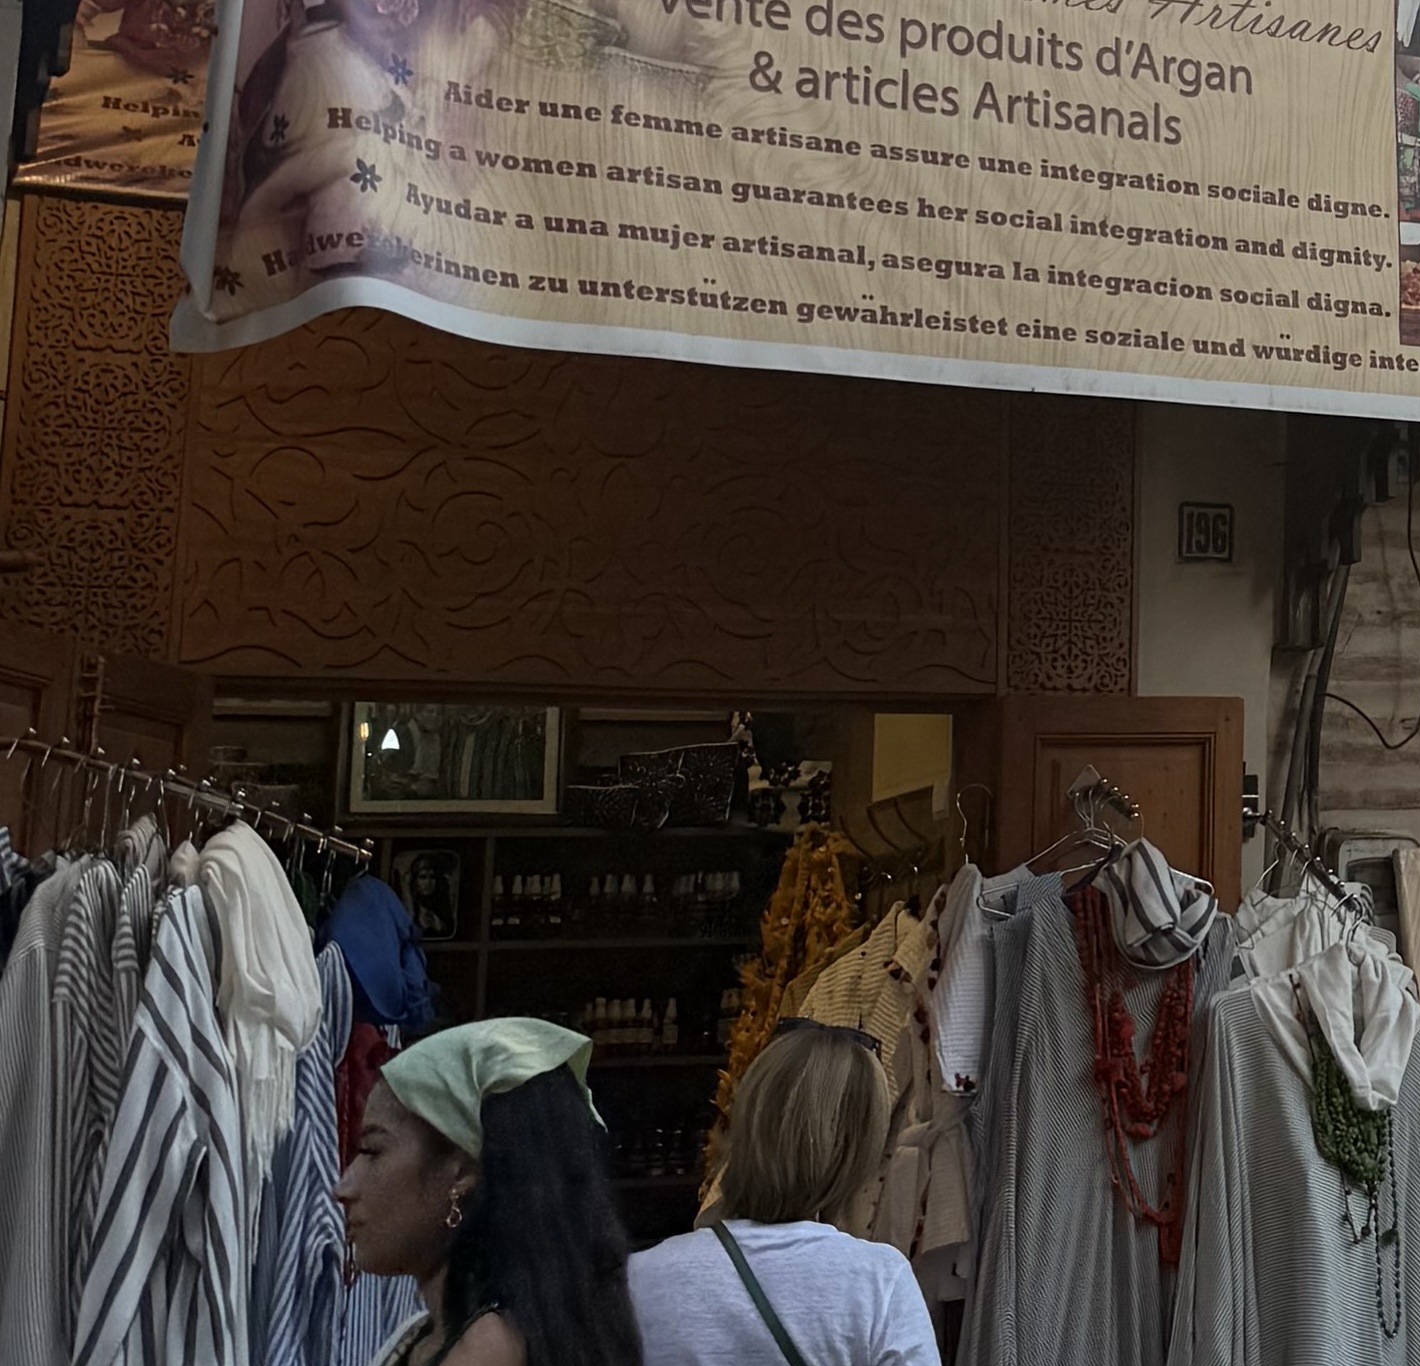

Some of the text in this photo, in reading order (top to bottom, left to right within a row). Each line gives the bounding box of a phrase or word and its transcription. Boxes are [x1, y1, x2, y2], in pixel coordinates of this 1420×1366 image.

[805, 0, 884, 44] des
[900, 17, 1083, 72] produits
[1095, 36, 1252, 97] d'Argan
[102, 96, 200, 118] Helpin
[749, 51, 1181, 145] & articles Artisanals
[327, 106, 1393, 272] Helping a women artisan guarantees her social integration and dignity.
[445, 80, 1390, 219] Aider une femme artisane assure une integration sociale digne.
[405, 182, 1392, 319] Ayudar a una mujer artisanal, asegura la integracion social digna.
[528, 274, 570, 296] zu
[578, 276, 788, 319] unterstützen
[796, 293, 1009, 338] gewährleistet
[1016, 318, 1077, 345] eine
[1086, 325, 1185, 353] soziale
[1192, 335, 1246, 360] und
[1252, 332, 1362, 371] würdige
[1186, 512, 1227, 554] 196
